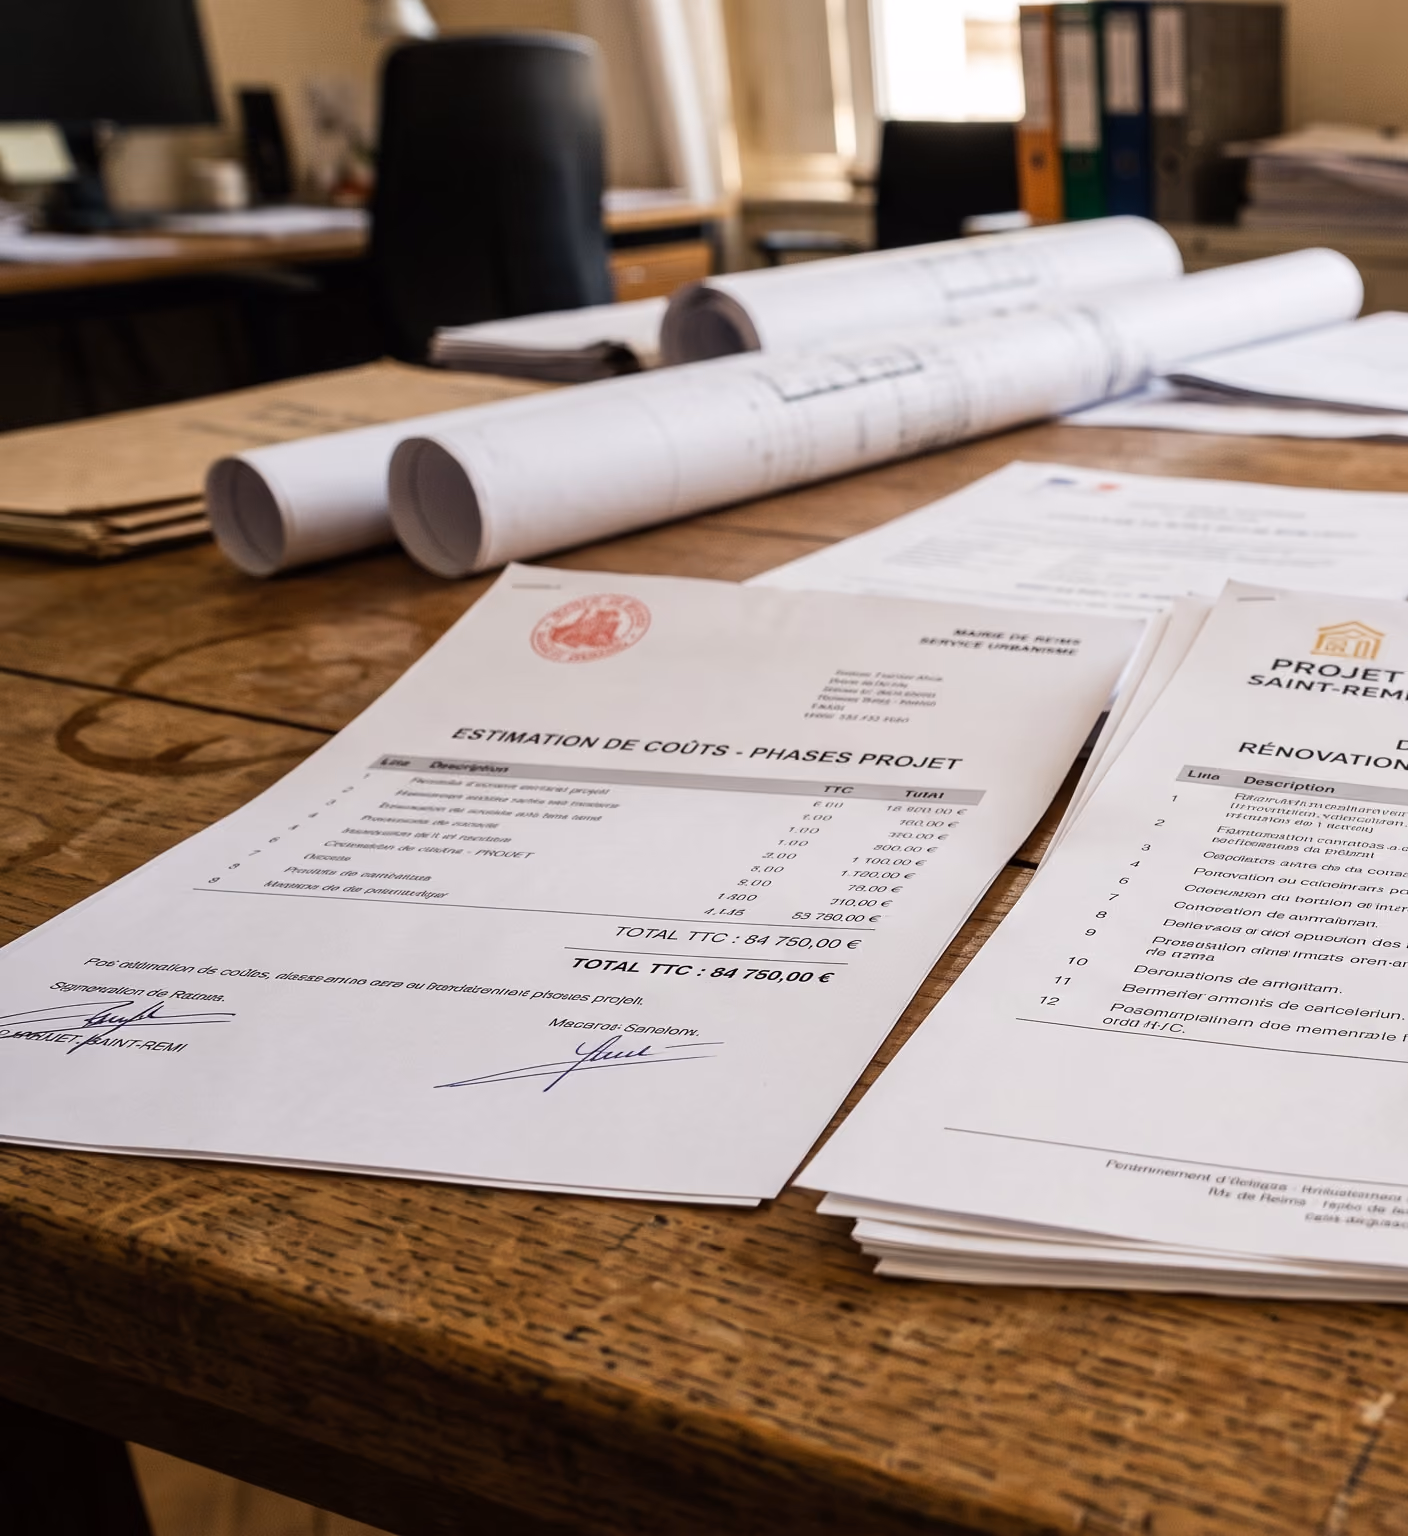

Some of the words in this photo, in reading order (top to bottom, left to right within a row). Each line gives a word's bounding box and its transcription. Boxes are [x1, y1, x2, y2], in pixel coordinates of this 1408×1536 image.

[1271, 658, 1405, 683] PROJET
[451, 726, 600, 750] ESTIMATION
[602, 738, 641, 752] DE
[644, 739, 730, 758] COÛTS
[749, 746, 852, 765] PHASES
[858, 752, 963, 771] PROJET
[1243, 775, 1336, 794] Description
[1154, 818, 1166, 827] 2
[1141, 843, 1152, 852] 3
[1129, 859, 1141, 868] 4
[1118, 876, 1130, 885] 6
[1108, 892, 1119, 902] 7
[1095, 910, 1108, 919] 8
[615, 925, 678, 941] TOTAL
[688, 930, 729, 944] TTC
[744, 934, 771, 946] 84
[775, 935, 842, 950] 750,00
[846, 938, 863, 950] €
[1084, 928, 1097, 937] 9
[1067, 956, 1089, 967] 10
[571, 957, 640, 973] TOTAL
[649, 962, 693, 977] TTC
[709, 966, 737, 979] 84
[742, 968, 814, 984] 750,00
[817, 972, 835, 984] €
[1054, 974, 1072, 987] 11
[1040, 995, 1061, 1007] 12
